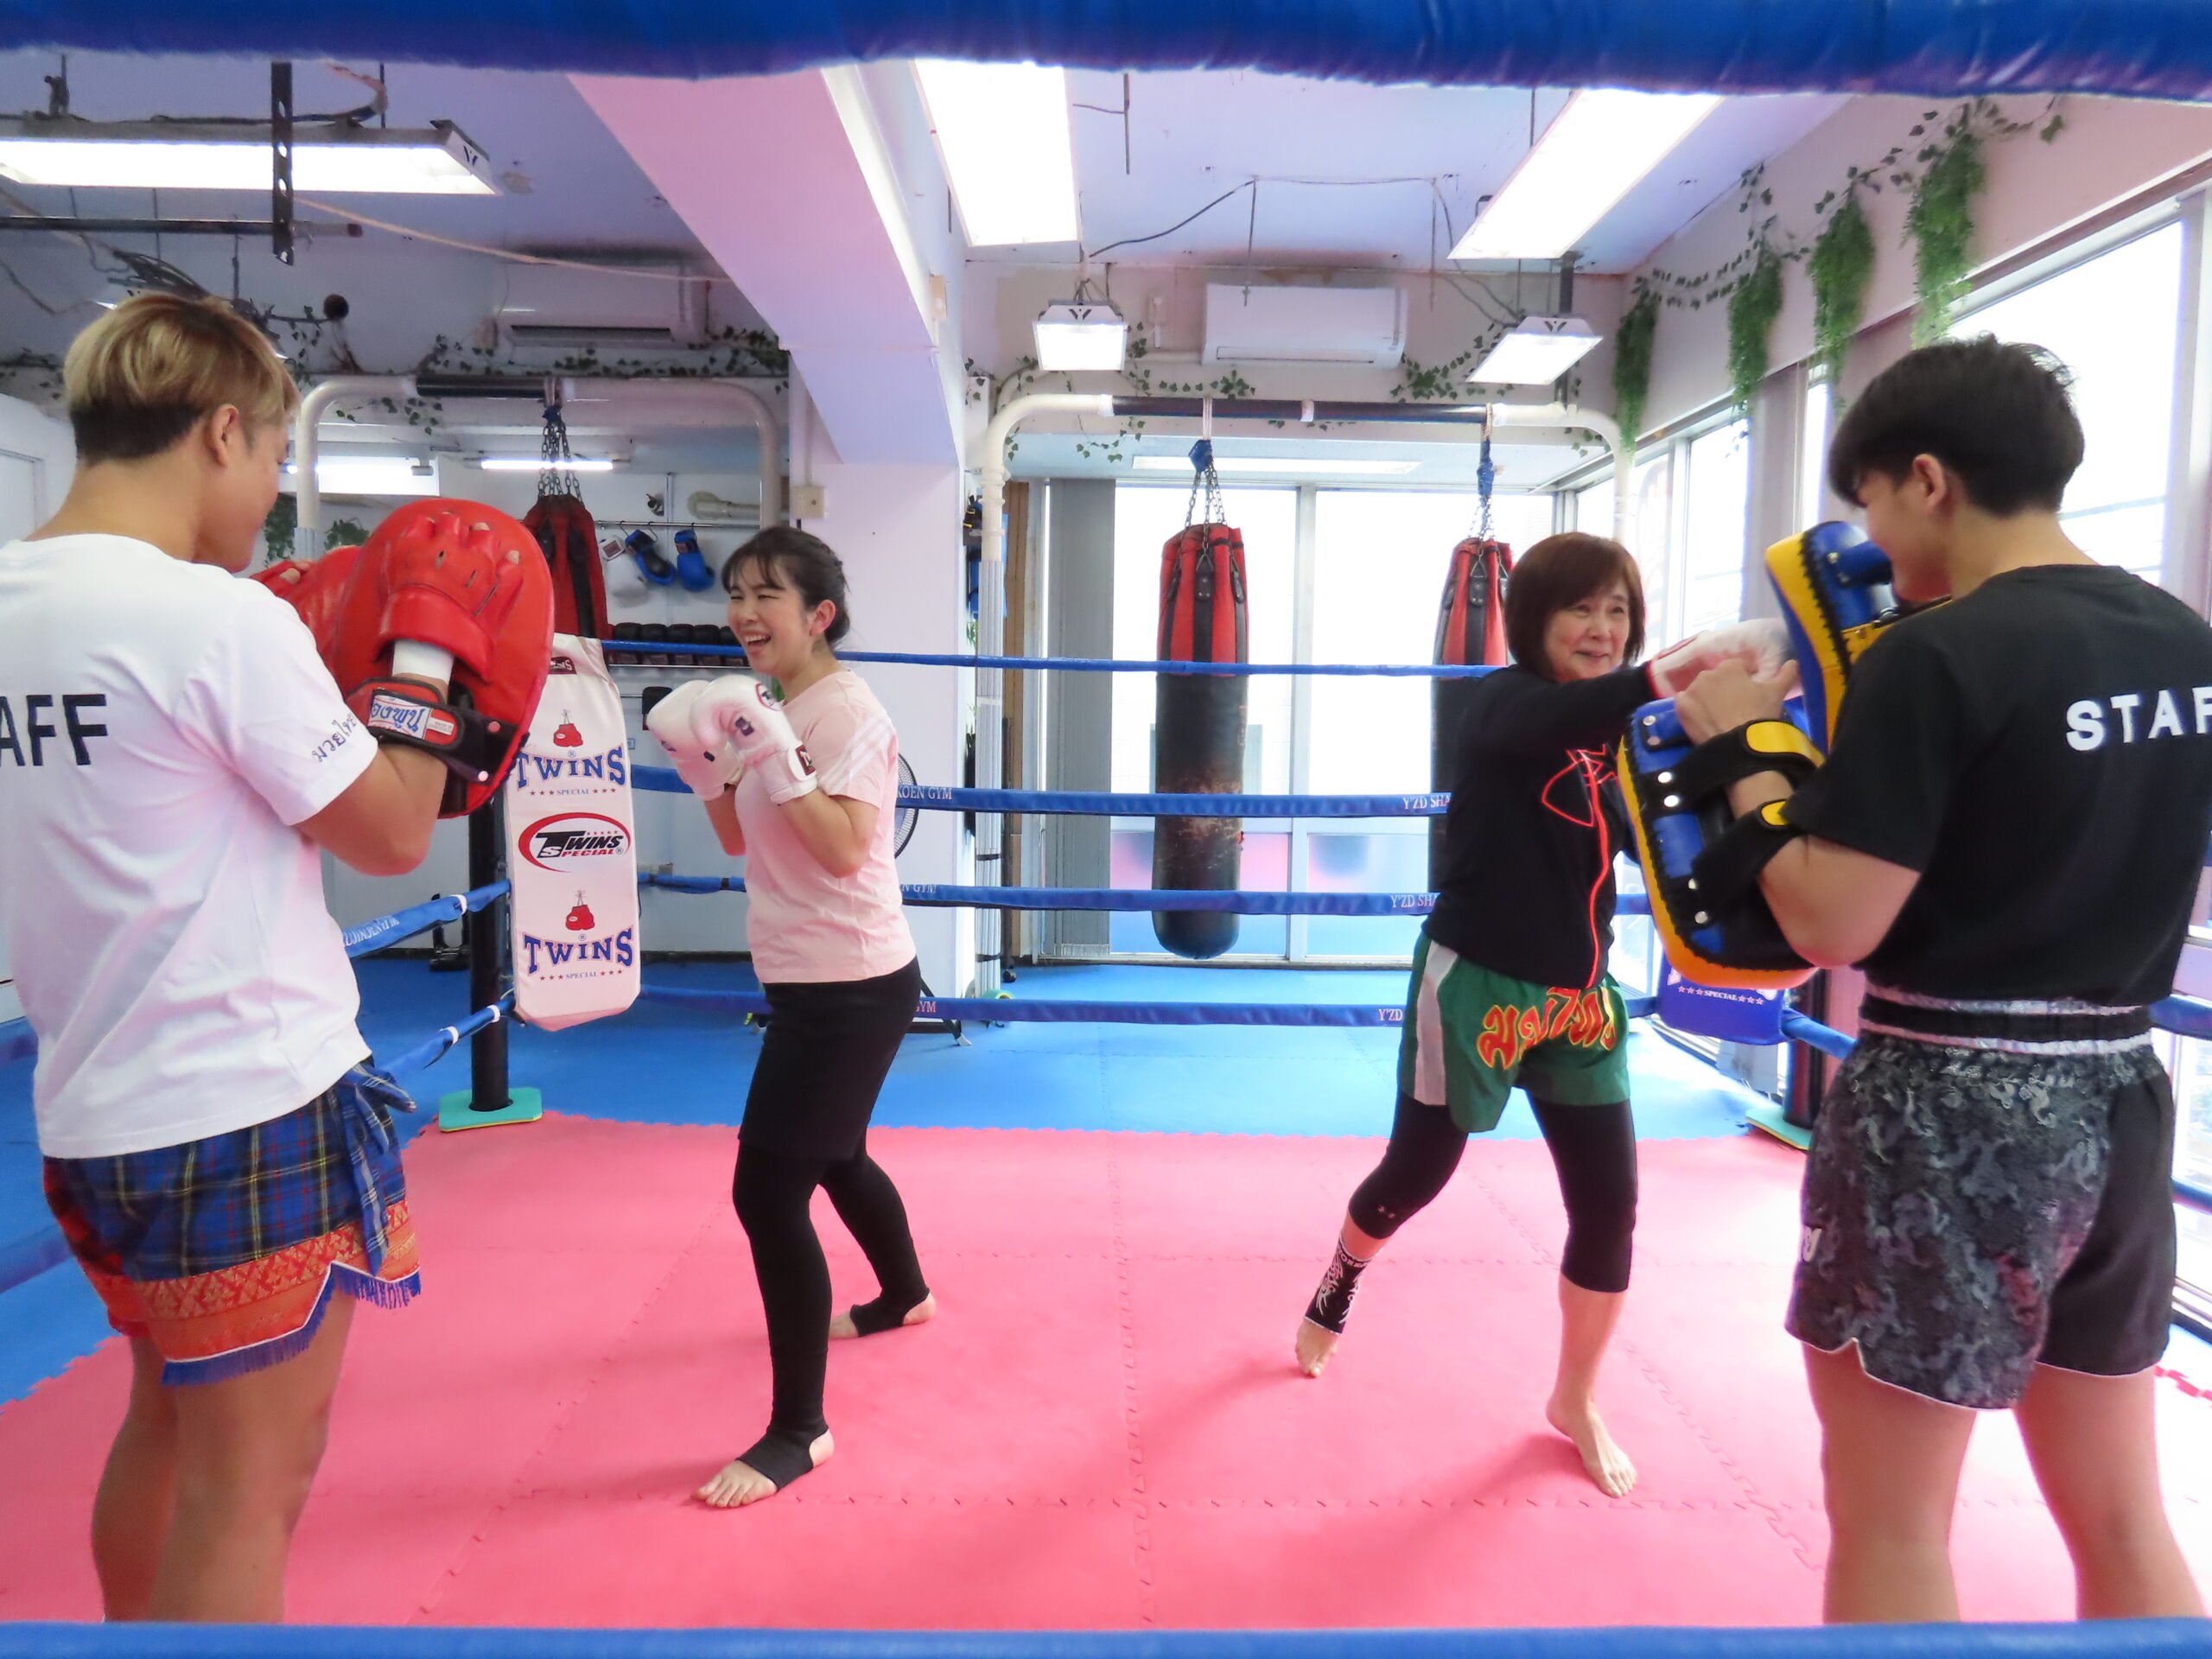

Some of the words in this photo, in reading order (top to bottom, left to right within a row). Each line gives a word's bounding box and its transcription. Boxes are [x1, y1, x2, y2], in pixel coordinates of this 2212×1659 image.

[516, 744, 627, 791] TWINS
[556, 788, 590, 797] SPECIAL
[928, 787, 953, 800] GYM
[536, 830, 624, 858] TWINS
[1390, 894, 1415, 908] Y'ZD
[523, 926, 635, 976] TWINS
[565, 970, 598, 980] SPECIAL
[1703, 989, 1738, 1001] SPECIAL
[1378, 1007, 1403, 1021] Y'ZD
